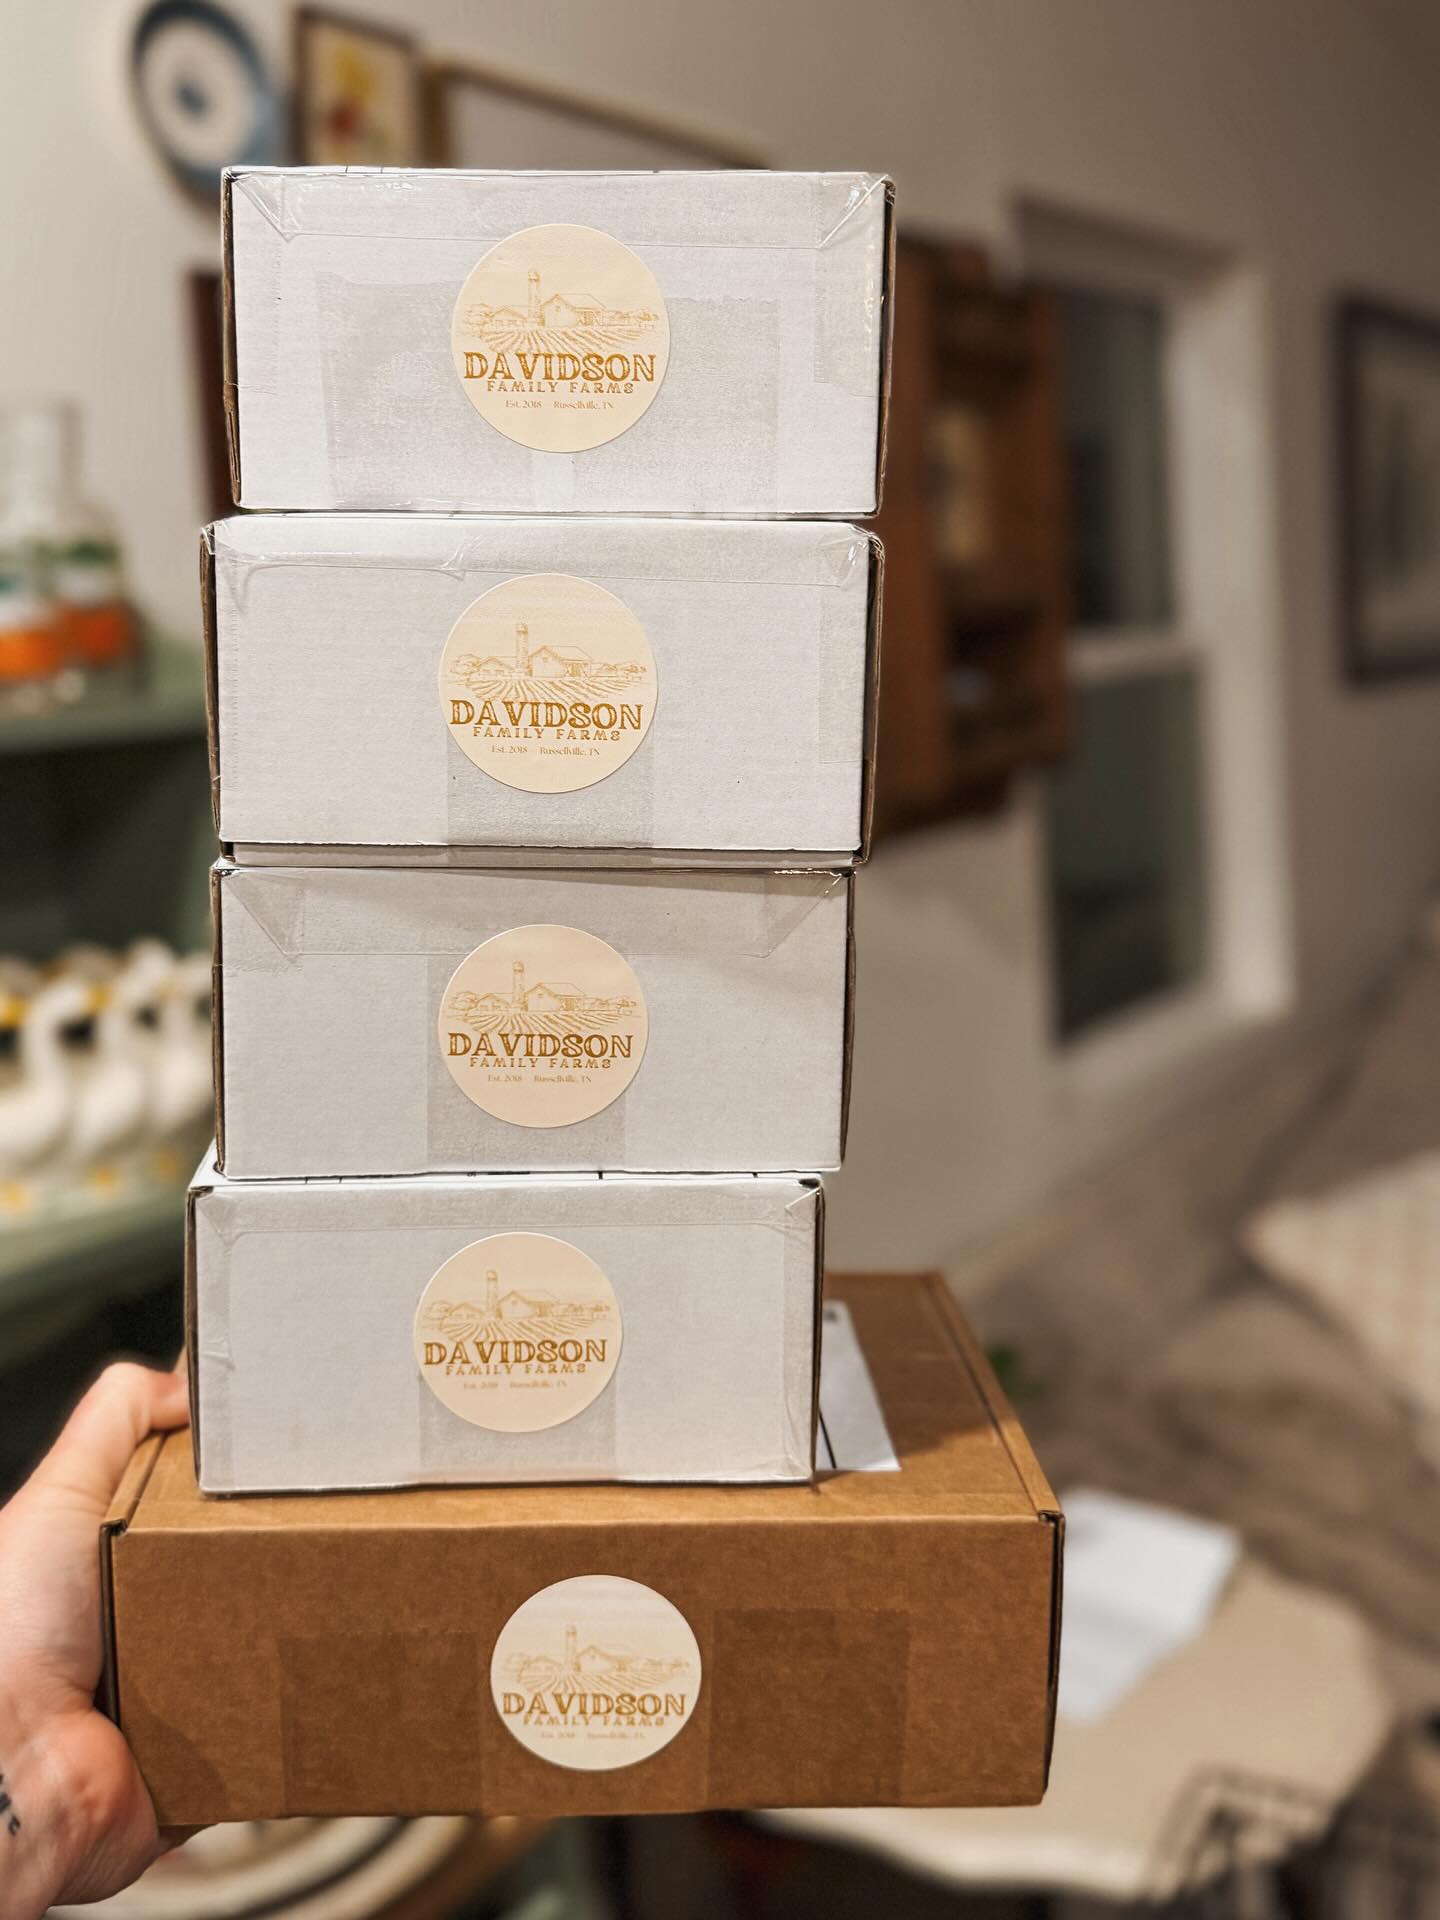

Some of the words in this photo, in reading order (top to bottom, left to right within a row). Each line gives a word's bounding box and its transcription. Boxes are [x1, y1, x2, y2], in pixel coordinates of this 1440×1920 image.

[464, 352, 656, 382] DAVIDSON
[487, 381, 558, 393] FAMILY
[569, 382, 634, 394] FARMS
[522, 400, 542, 409] 2018
[450, 700, 643, 730] DAVIDSON
[473, 726, 545, 739] FAMILY
[556, 729, 621, 741] FARMS
[508, 746, 528, 754] 2018
[448, 1033, 633, 1058] DAVIDSON
[470, 1057, 538, 1068] FAMILY
[549, 1058, 611, 1069] FARMS
[424, 1339, 607, 1365] DAVIDSON
[503, 1692, 686, 1716] DAVIDSON
